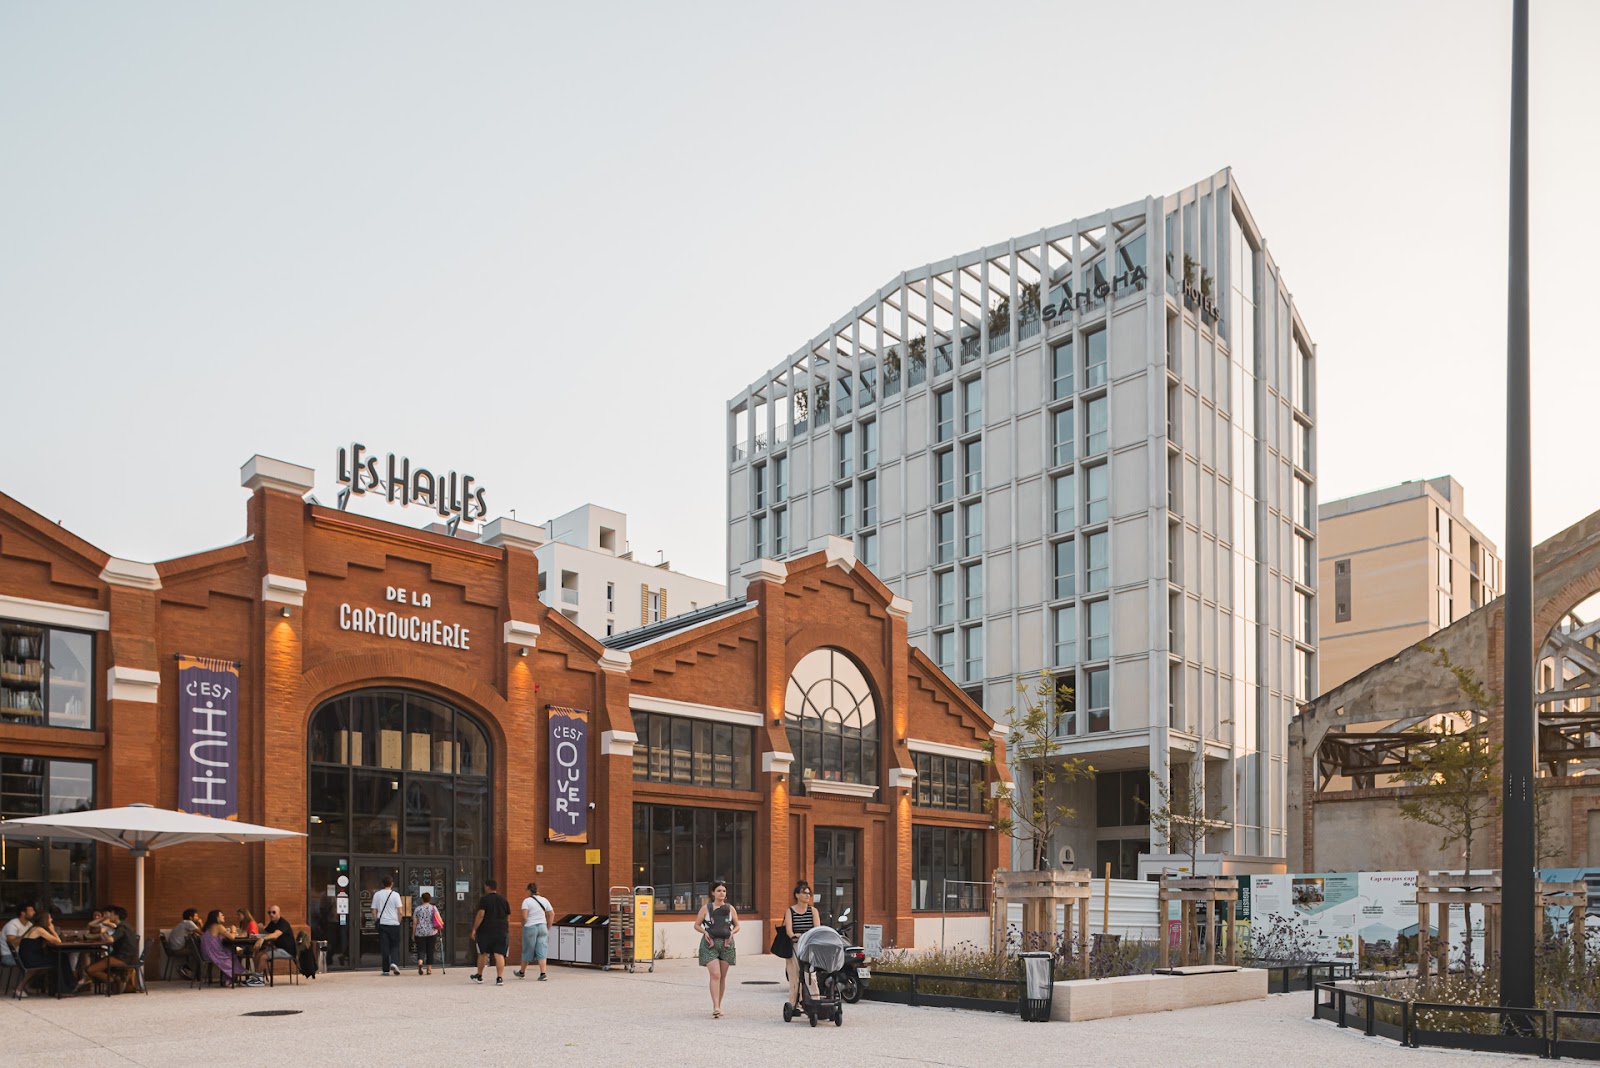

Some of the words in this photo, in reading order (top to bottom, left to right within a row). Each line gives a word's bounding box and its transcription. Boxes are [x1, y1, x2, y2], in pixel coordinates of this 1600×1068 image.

[1042, 265, 1148, 321] SANGHA
[1182, 279, 1221, 321] HOTELS
[337, 442, 379, 495] LES
[386, 452, 487, 523] HALLES
[386, 586, 407, 604] DE
[411, 591, 432, 608] LA
[339, 603, 470, 650] CARTOUCHERIE
[186, 680, 232, 701] C'EST
[553, 725, 583, 742] C'EST
[556, 741, 580, 825] OUVERT
